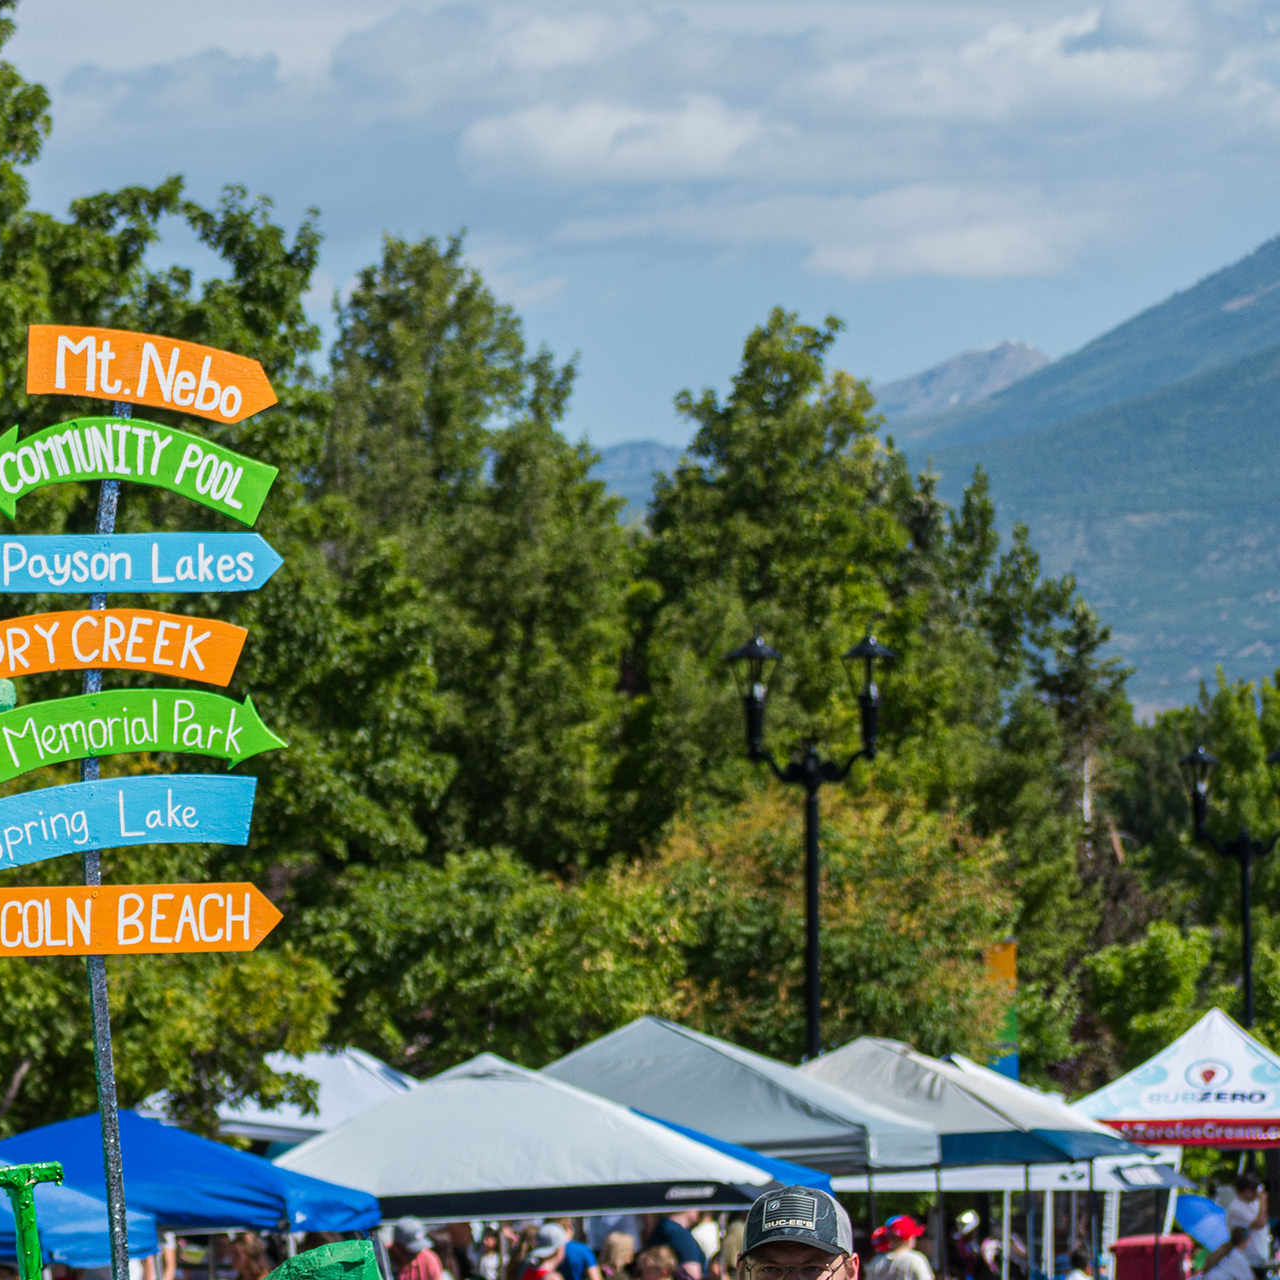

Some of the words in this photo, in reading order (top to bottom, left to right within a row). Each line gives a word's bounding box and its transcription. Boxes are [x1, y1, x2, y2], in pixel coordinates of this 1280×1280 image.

[54, 335, 131, 395] Mt.
[137, 342, 242, 418] Nebo
[175, 443, 243, 510] POOL
[3, 542, 131, 587] Payson
[151, 543, 255, 584] Lakes
[71, 615, 212, 671] CREEK
[2, 699, 158, 768] Memorial
[173, 700, 243, 754] Park
[119, 789, 199, 837] Lake
[118, 893, 251, 944] BEACH
